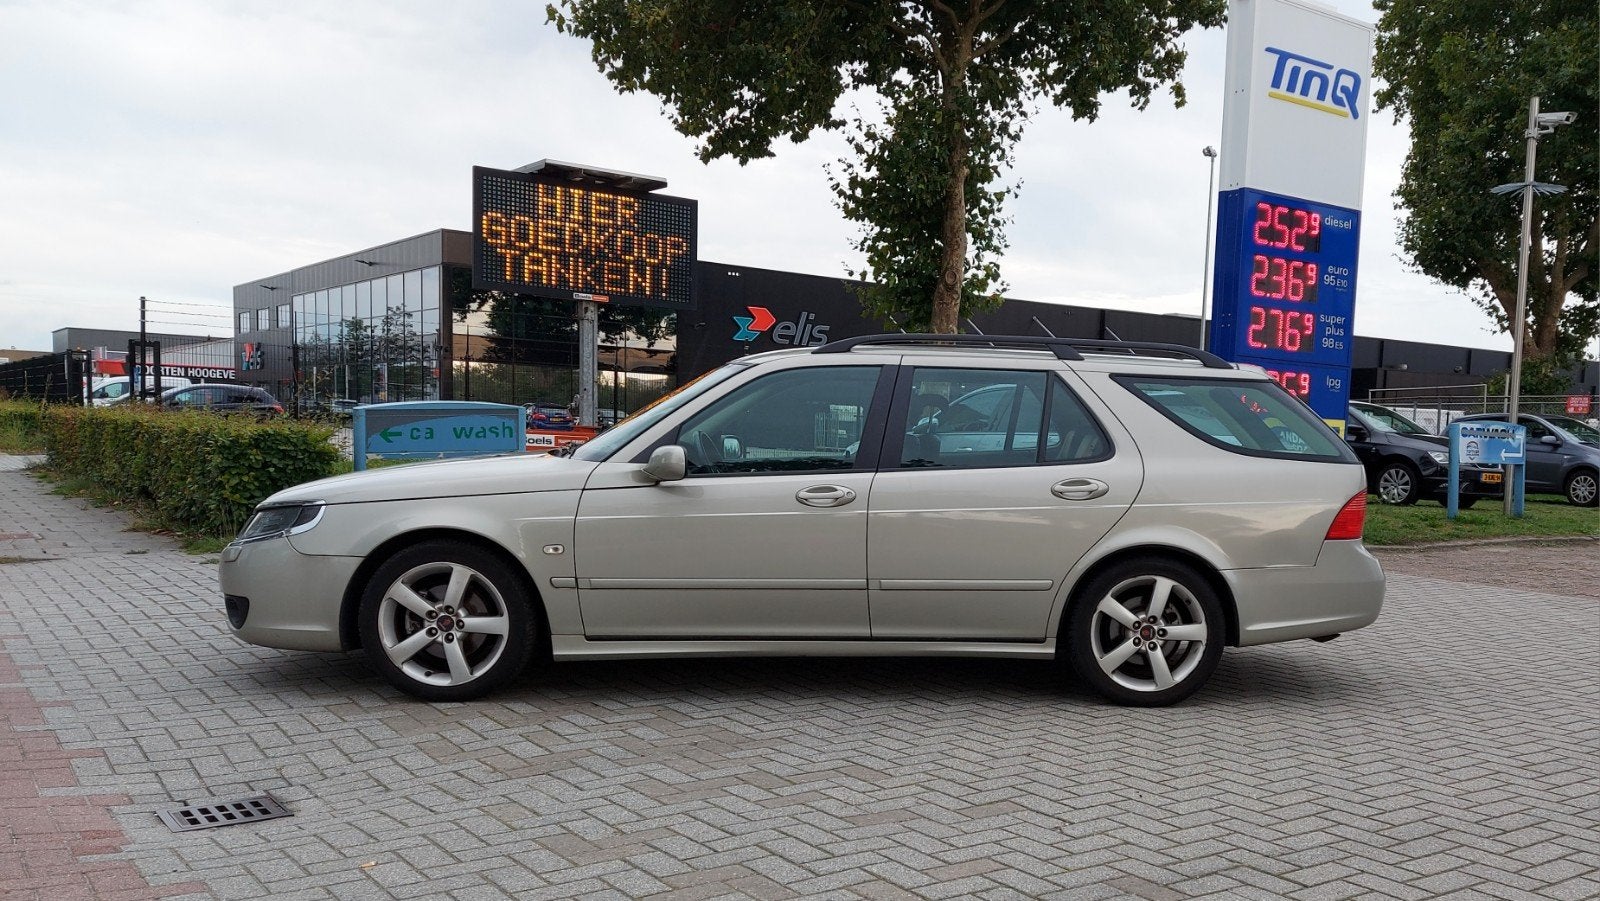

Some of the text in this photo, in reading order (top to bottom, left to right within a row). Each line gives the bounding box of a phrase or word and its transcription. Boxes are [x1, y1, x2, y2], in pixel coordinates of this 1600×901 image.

[538, 182, 639, 227] HIER
[1324, 214, 1352, 230] diesel
[481, 210, 687, 265] GOEDKOOP
[497, 247, 668, 297] TANKEN!
[1328, 265, 1349, 276] euro
[1324, 274, 1348, 288] 95 E10
[1320, 314, 1346, 325] super
[772, 311, 830, 347] elis
[1325, 325, 1345, 337] plus
[1322, 337, 1344, 350] 98 E5
[187, 367, 236, 379] HOOGEVE
[1326, 375, 1341, 389] lpg
[453, 421, 514, 439] wash
[526, 436, 553, 446] oels
